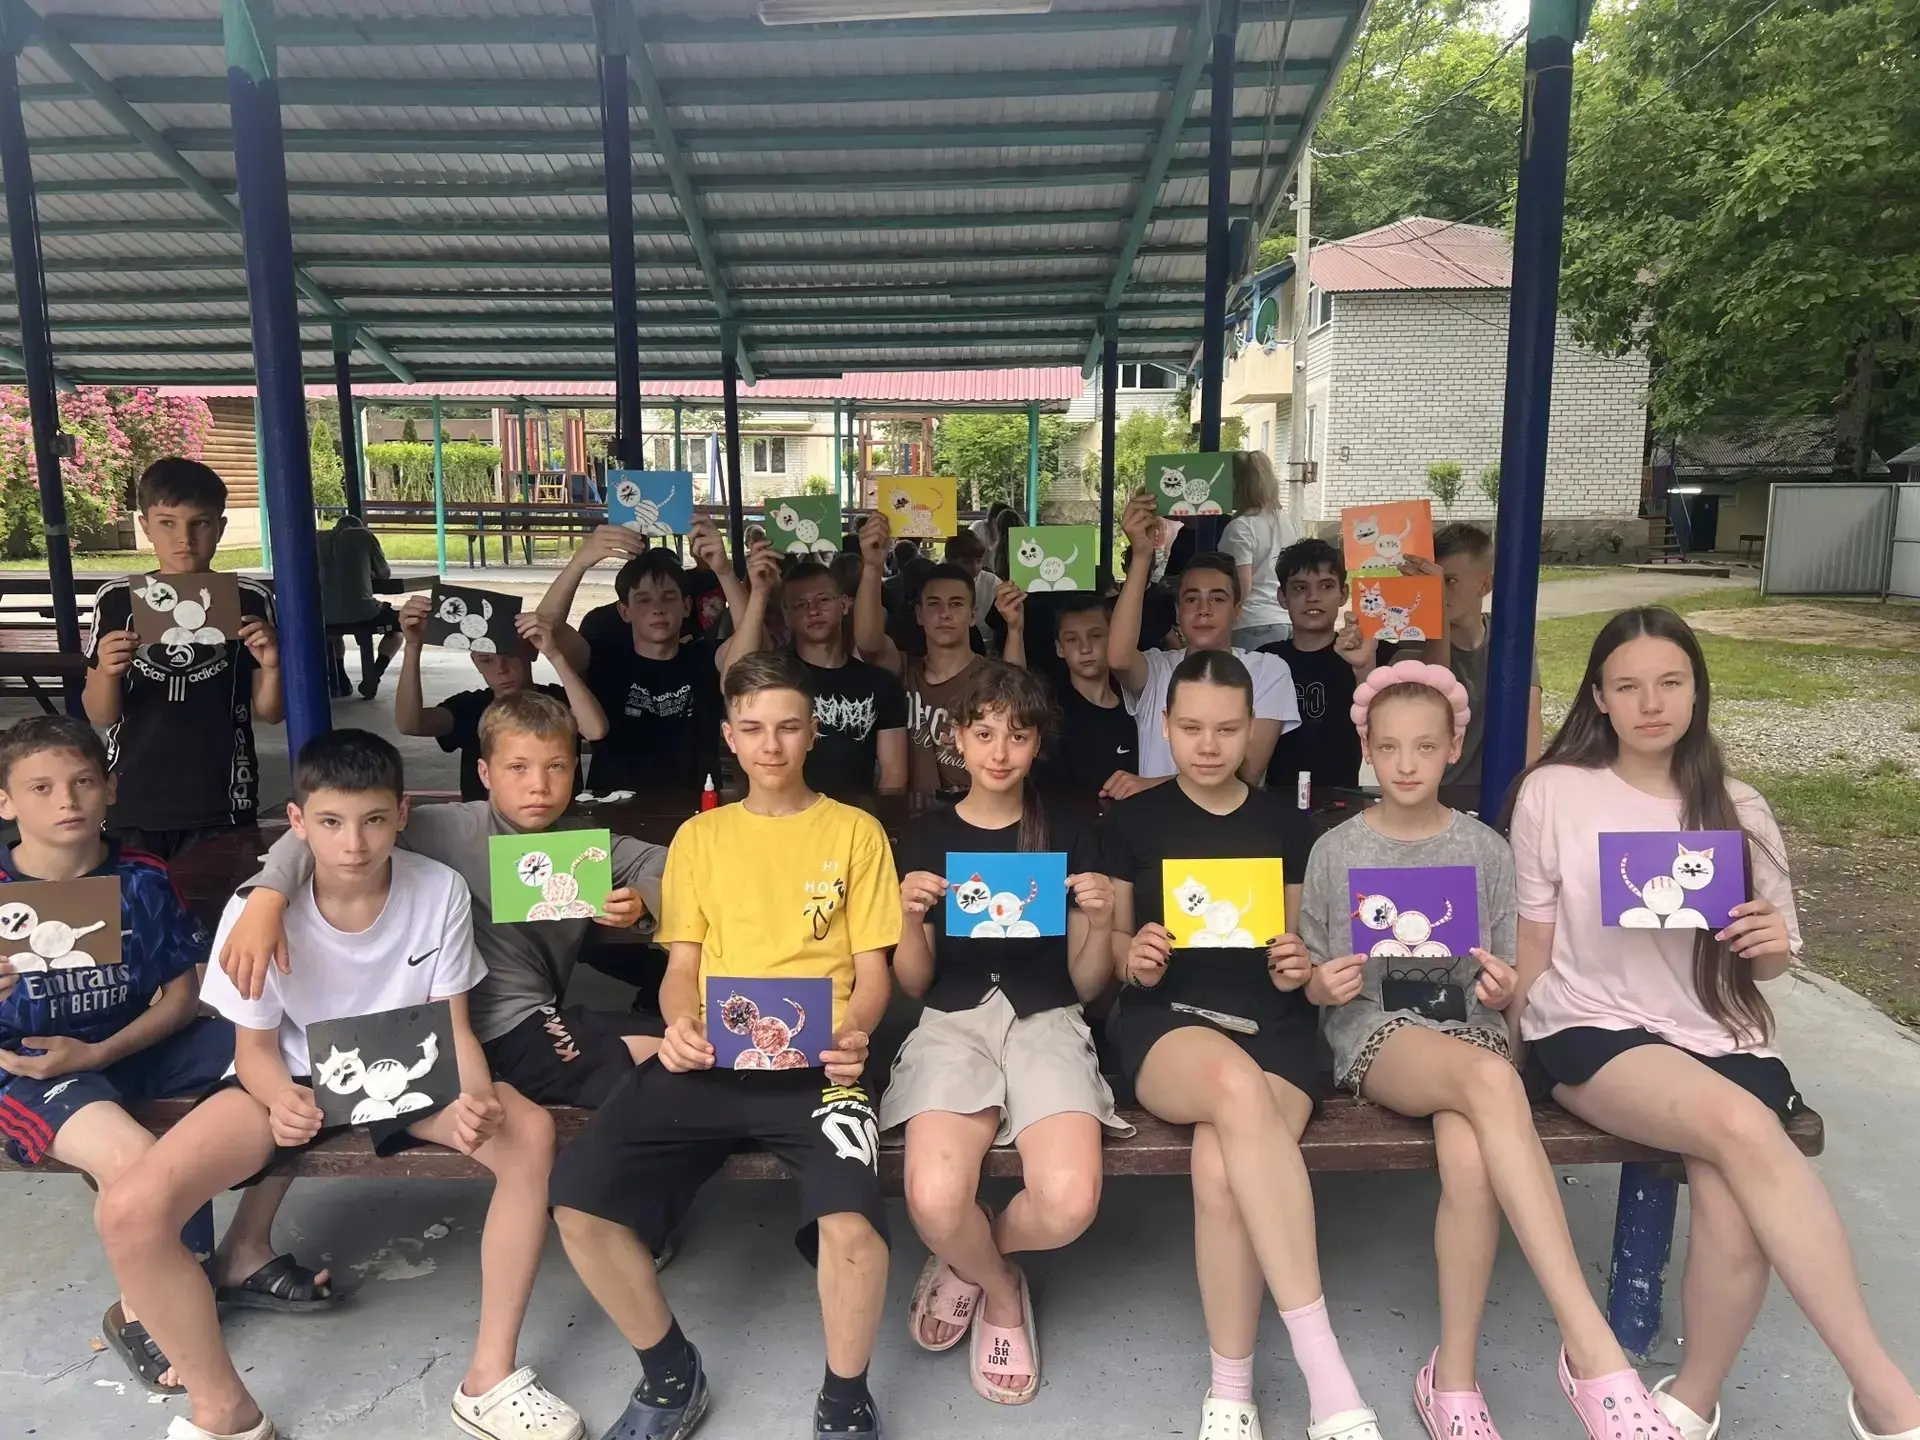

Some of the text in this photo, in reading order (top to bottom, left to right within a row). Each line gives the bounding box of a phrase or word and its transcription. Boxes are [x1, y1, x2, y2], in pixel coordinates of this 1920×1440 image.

[188, 659, 228, 683] adidas
[822, 860, 839, 873] HI
[23, 964, 130, 1000] Emirats
[71, 984, 130, 1014] BETTER
[955, 1301, 970, 1310] SH
[994, 1337, 1011, 1348] FA
[994, 1347, 1010, 1357] SH
[988, 1355, 1009, 1366] ION
